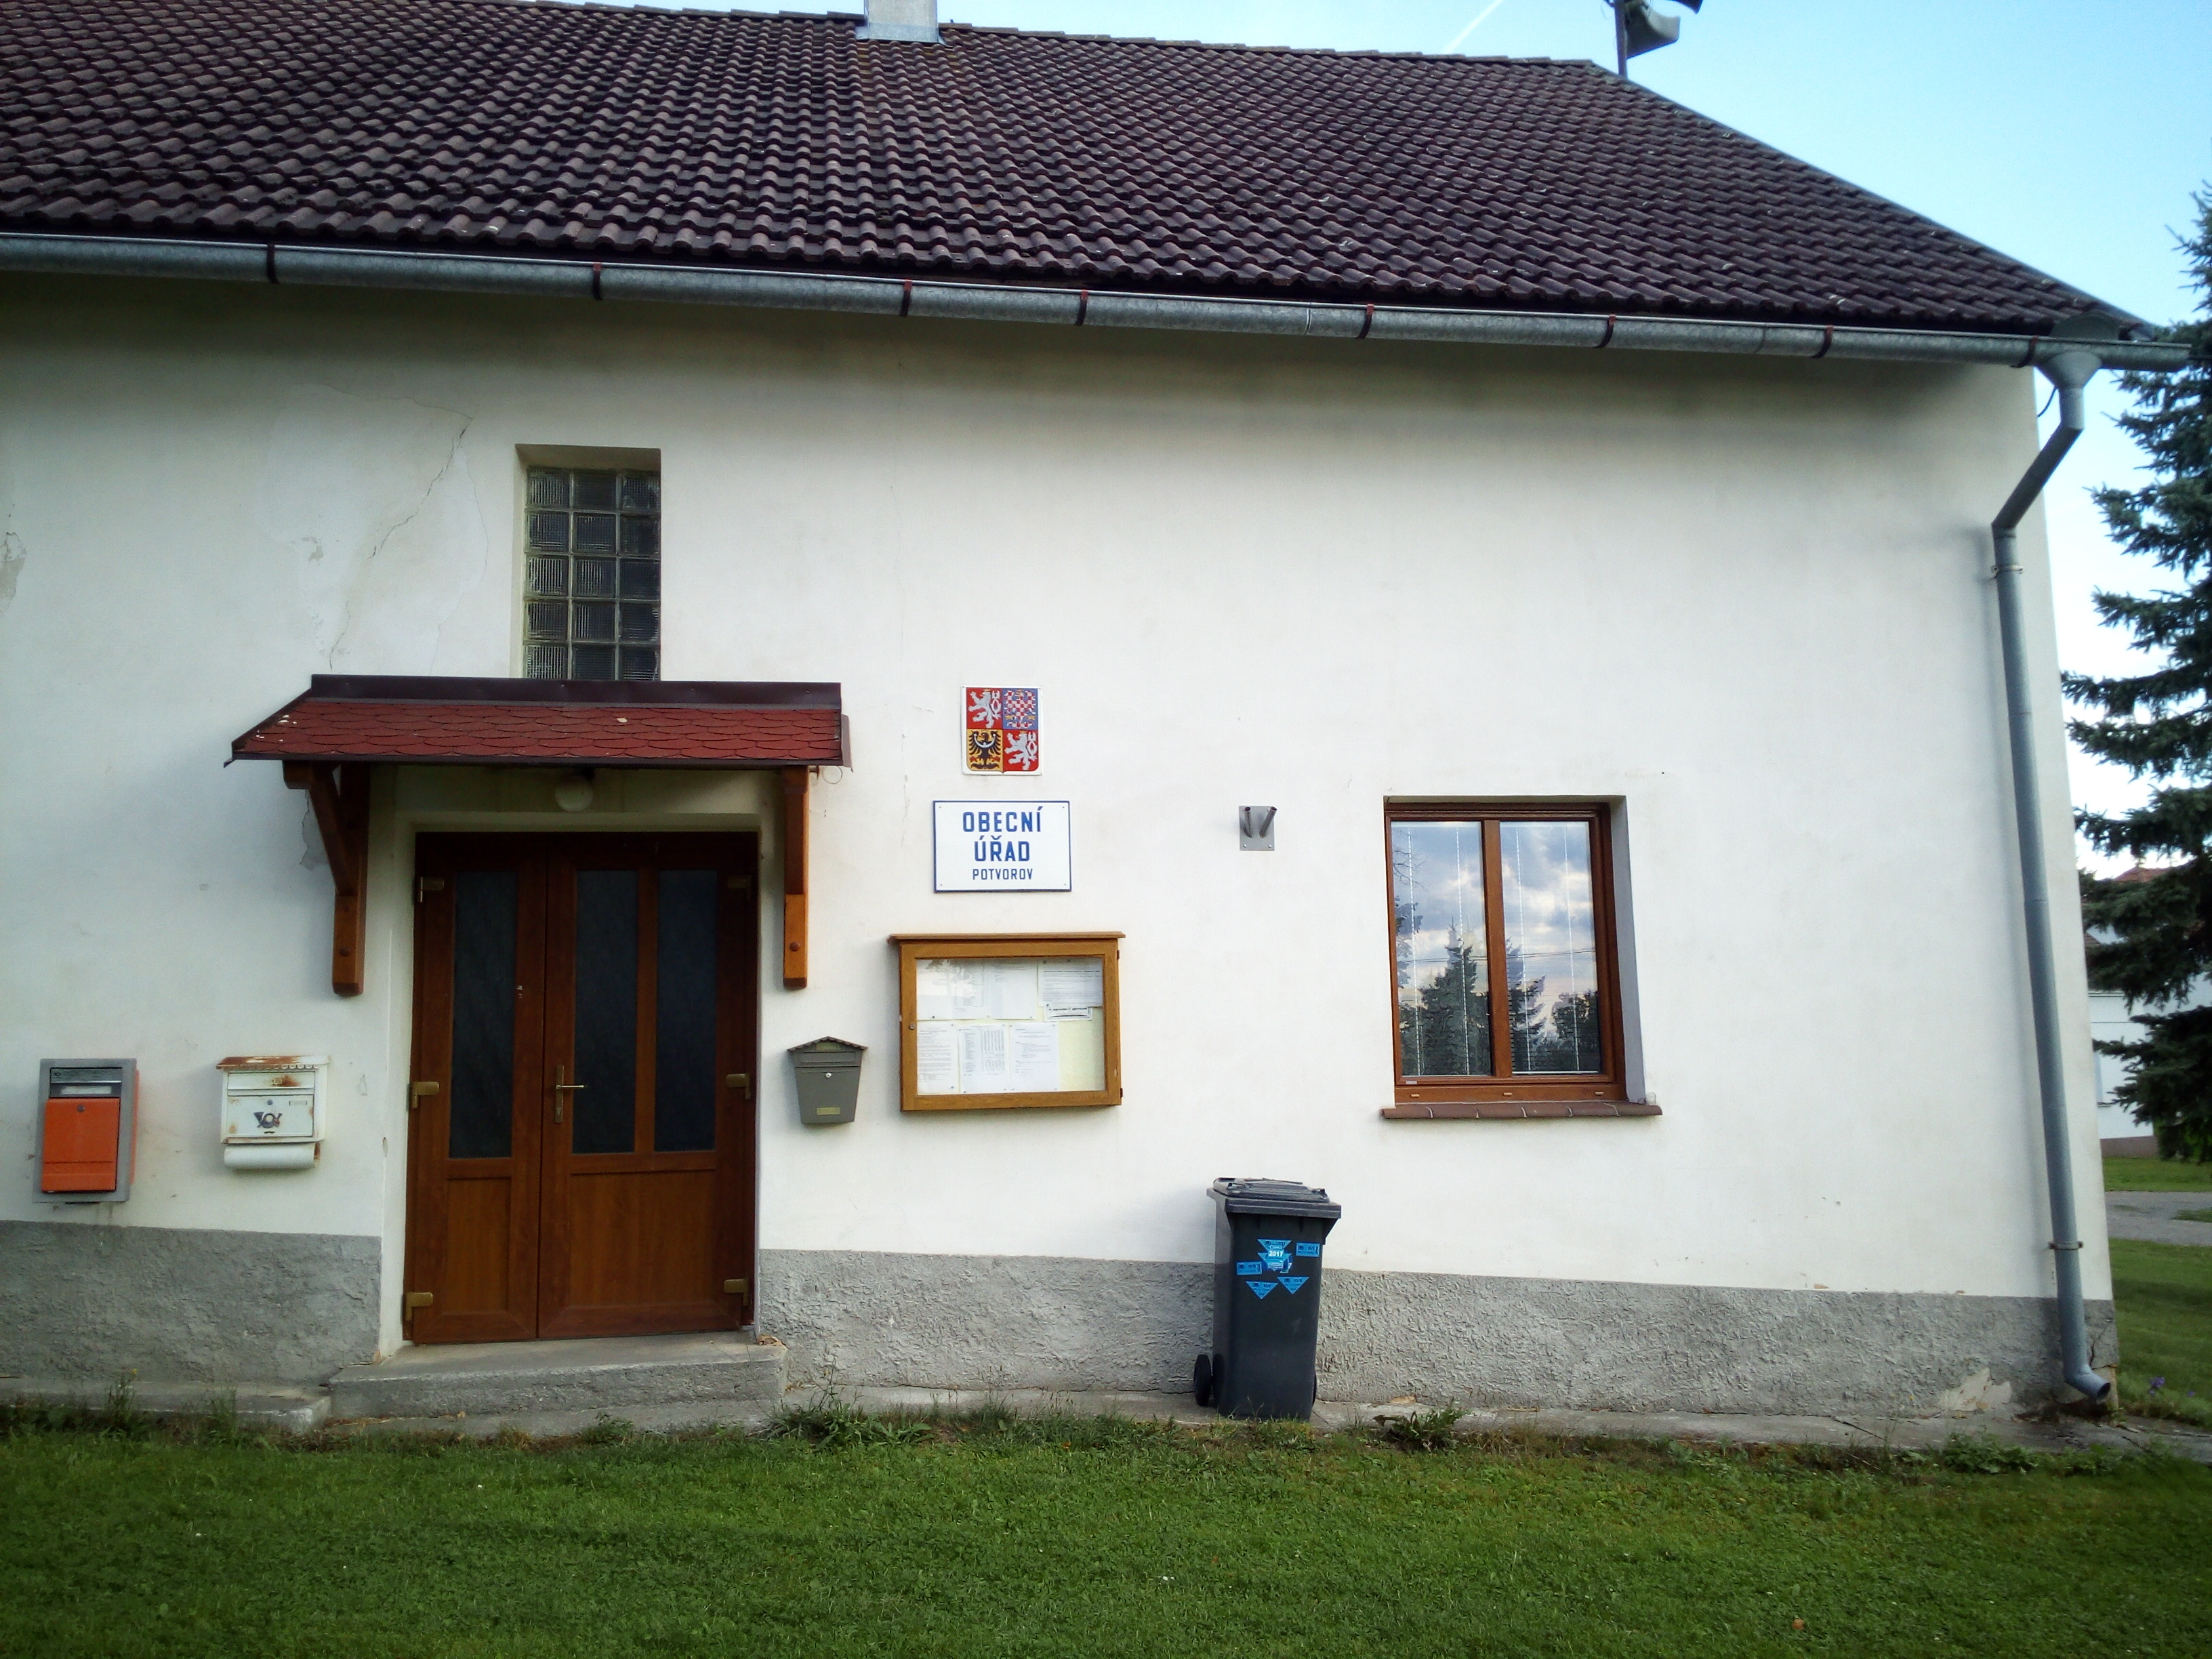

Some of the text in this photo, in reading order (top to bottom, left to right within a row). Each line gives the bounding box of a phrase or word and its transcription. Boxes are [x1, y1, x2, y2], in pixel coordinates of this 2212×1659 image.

[962, 806, 1043, 832] OBECNÍ
[974, 835, 1030, 861] ÚŘAD
[972, 868, 1033, 880] POTVOROV
